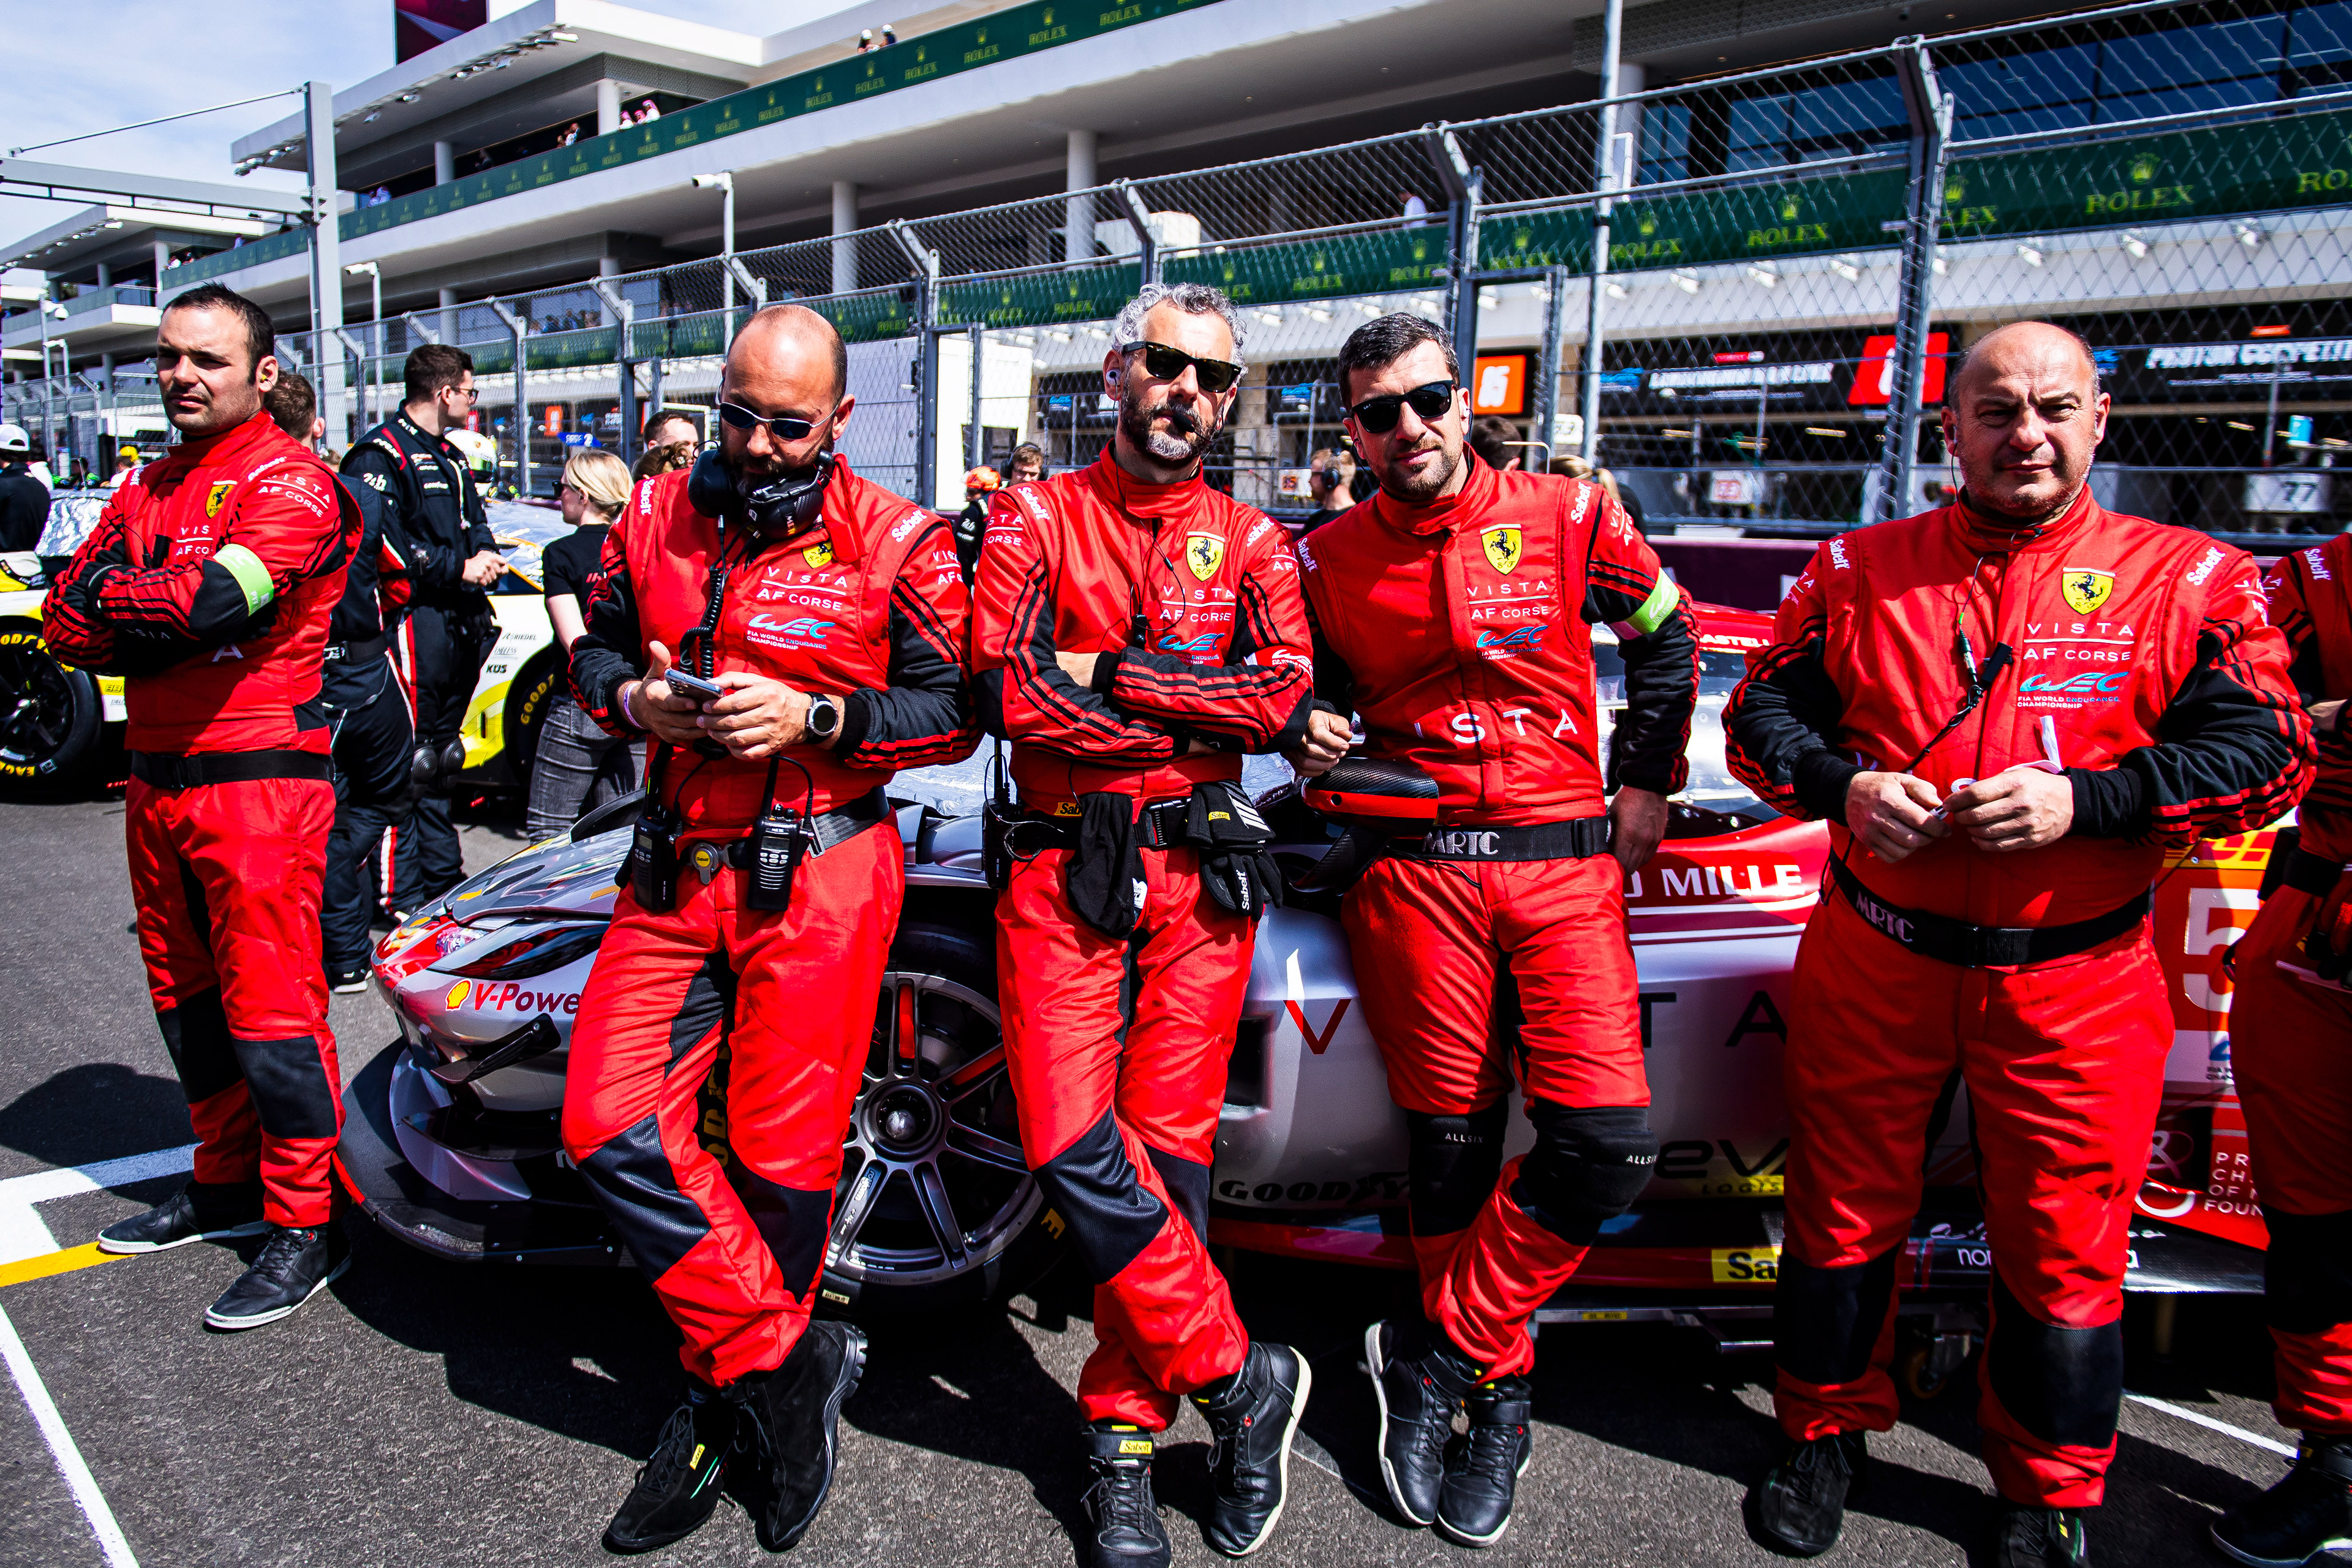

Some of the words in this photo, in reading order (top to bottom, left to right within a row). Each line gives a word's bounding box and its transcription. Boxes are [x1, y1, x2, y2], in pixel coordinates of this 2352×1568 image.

[1099, 4, 1142, 26] ROLEX
[1028, 24, 1068, 45] ROLEX
[964, 44, 1000, 64] ROLEX
[905, 62, 937, 80] ROLEX
[855, 77, 885, 94] ROLEX
[805, 92, 833, 108] ROLEX
[758, 105, 784, 121] ROLEX
[2085, 186, 2194, 216] ROLEX
[1748, 222, 1830, 247] ROLEX
[267, 473, 330, 503] ISTA
[641, 478, 655, 515] Sabelt
[2283, 480, 2317, 502] 77
[285, 491, 325, 518] CORSE
[1017, 486, 1050, 520] Sabelt
[1570, 481, 1592, 524] Sabelt
[181, 525, 210, 535] VIS
[891, 509, 927, 543] Sabelt
[176, 545, 194, 556] AF
[984, 535, 1022, 546] CORSE
[1298, 537, 1317, 573] Sabelt
[1829, 538, 1850, 570] Sabelt
[2303, 548, 2332, 581] Sabelt
[1273, 560, 1294, 571] AF
[2187, 546, 2226, 586] Sabelt
[767, 566, 848, 588] VISTA
[1163, 585, 1235, 600] VISTA
[1467, 580, 1548, 597] VISTA
[756, 588, 785, 600] AF
[788, 594, 843, 611] CORSE
[1159, 608, 1184, 620] AF
[1190, 612, 1232, 622] CORSE
[1471, 608, 1496, 620] AF
[1502, 606, 1550, 618] CORSE
[748, 613, 835, 639] WEC
[1476, 625, 1549, 648] WEC
[2027, 622, 2135, 636] VISTA
[747, 636, 799, 650] CHAMPIONSHIP
[760, 632, 785, 643] WORLD
[785, 638, 827, 650] ENDURANCE
[1158, 633, 1225, 651] WEC
[2023, 647, 2057, 660] AF
[2064, 649, 2132, 662] CORSE
[105, 684, 125, 693] BB
[2019, 671, 2130, 692] WEC
[1414, 707, 1579, 744] ISTA
[1060, 803, 1081, 815] Sab
[1422, 829, 1500, 855] MRTC
[1235, 869, 1250, 911] Sabelt
[1662, 864, 1804, 897] MILLE
[1856, 890, 1915, 943] MRTC
[474, 982, 579, 1014] V-Powe
[1445, 1133, 1484, 1144] ALLSIX
[1124, 1441, 1149, 1452] Sabelt
